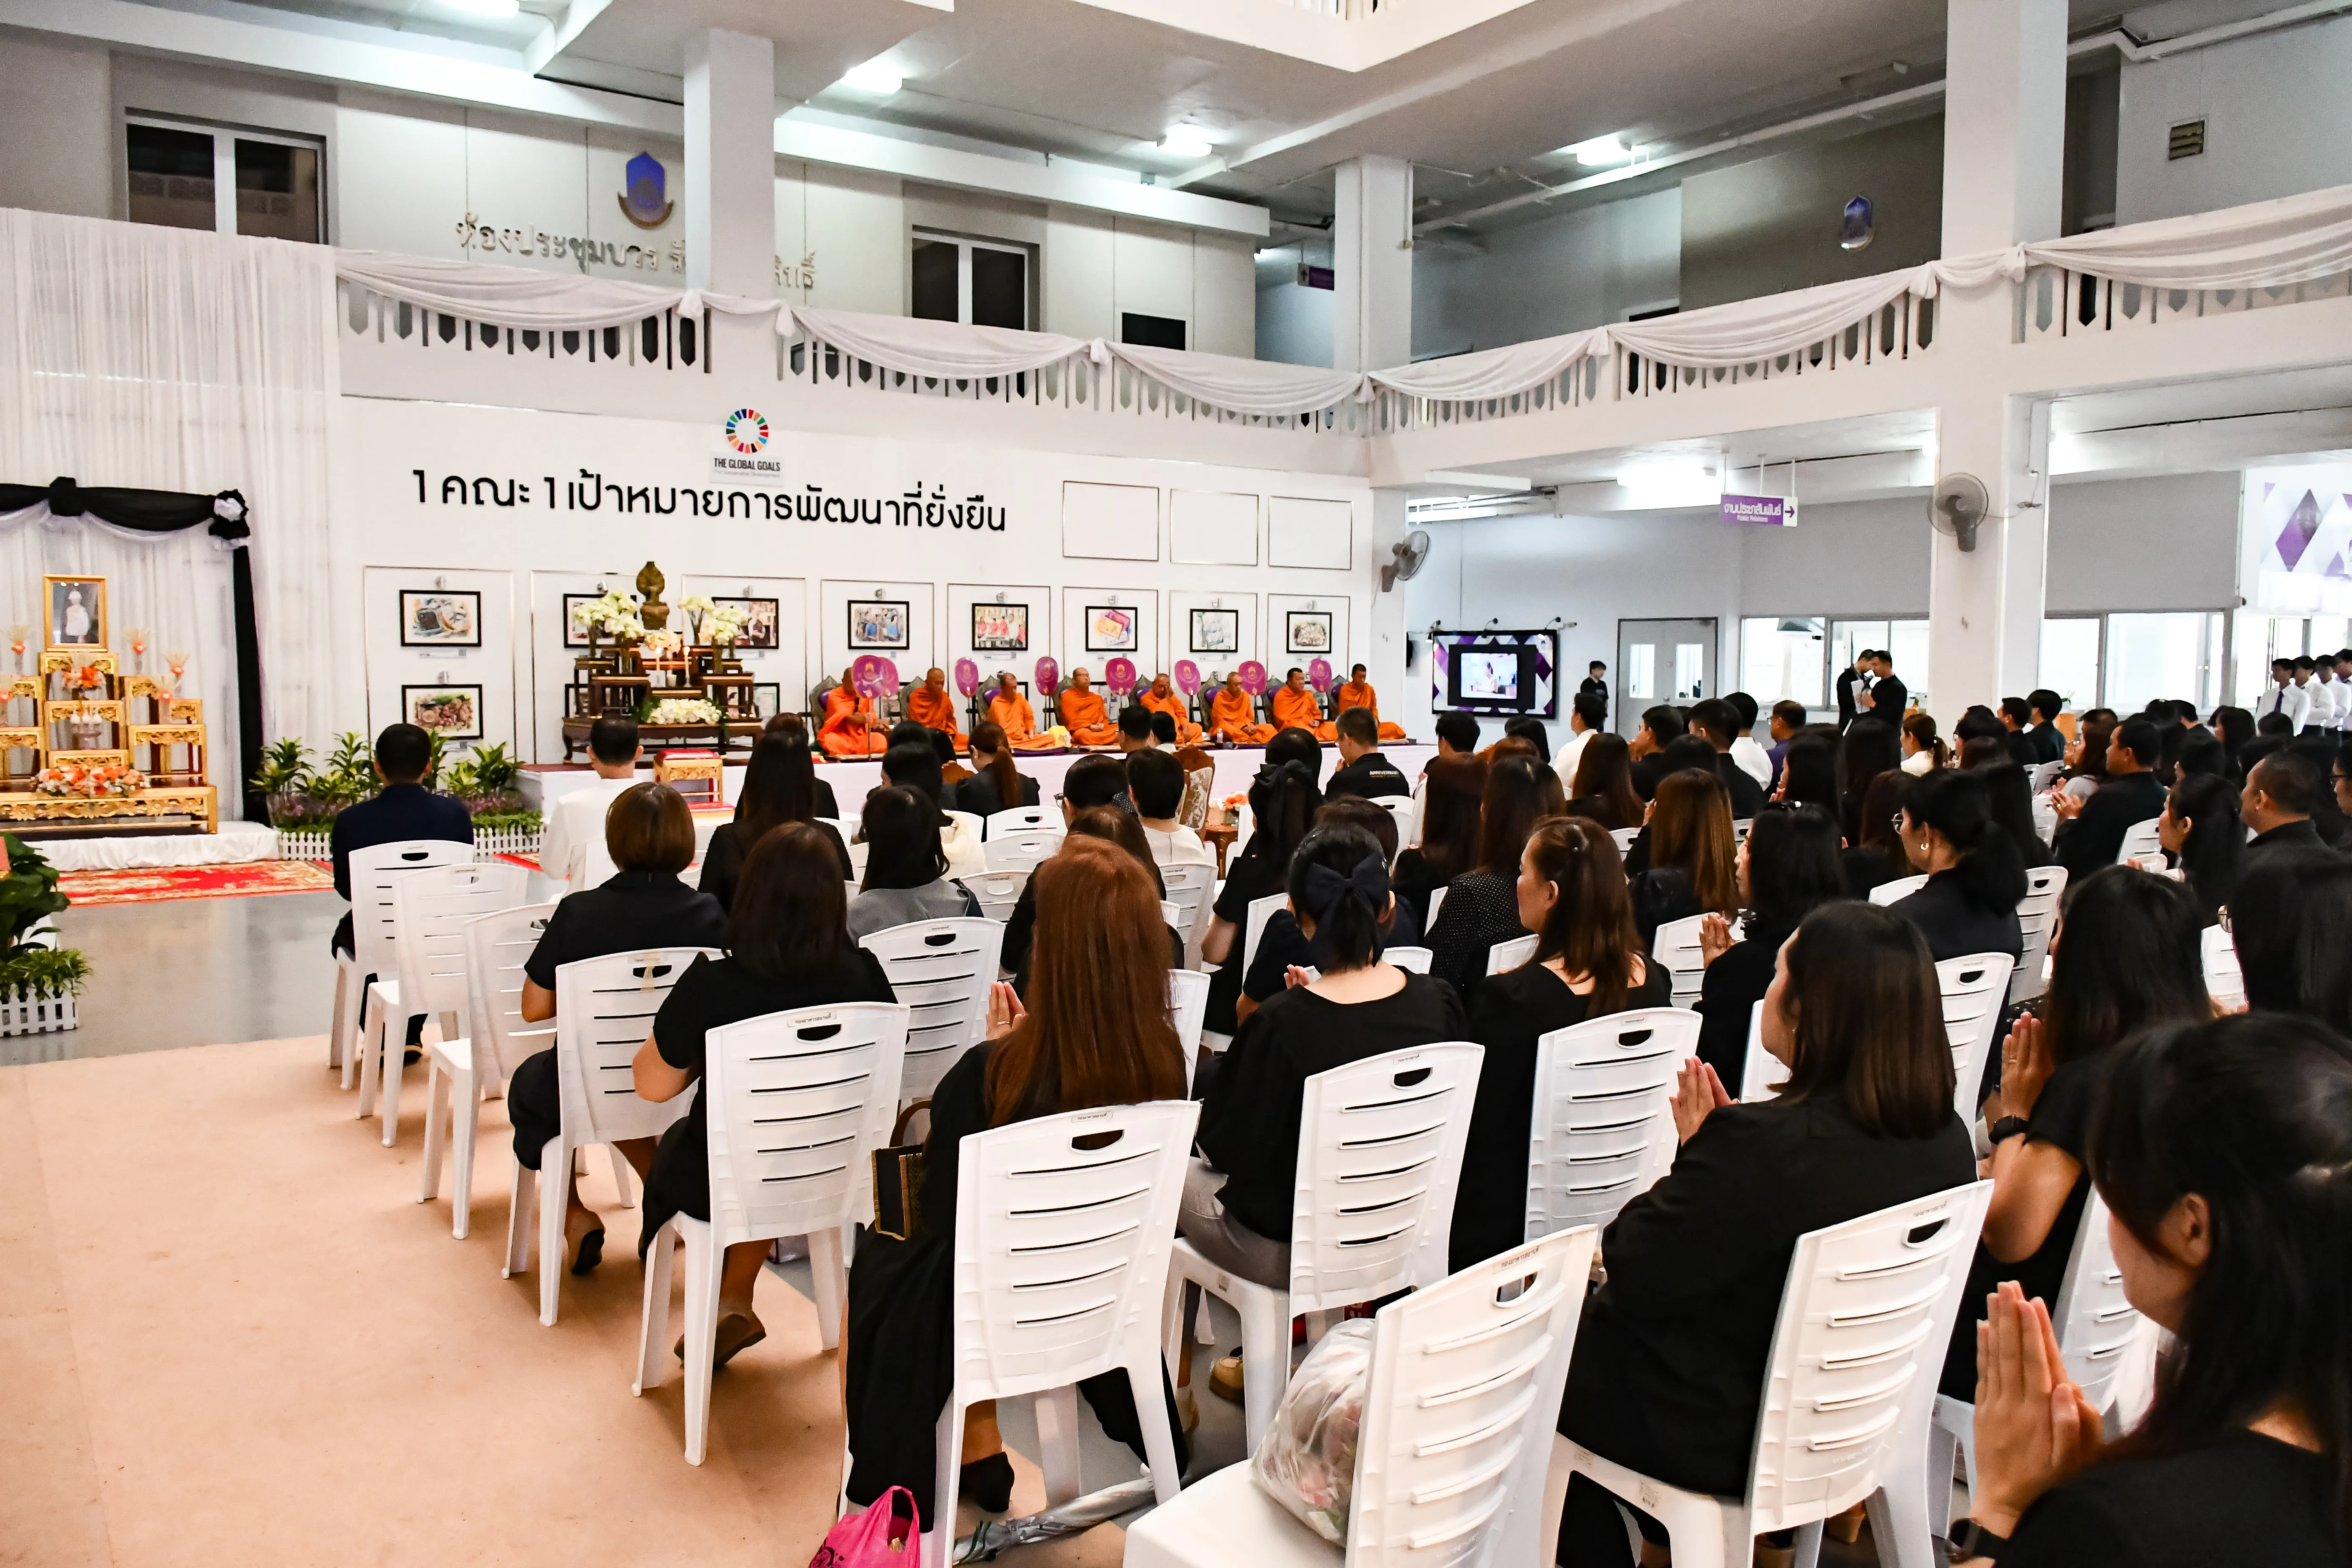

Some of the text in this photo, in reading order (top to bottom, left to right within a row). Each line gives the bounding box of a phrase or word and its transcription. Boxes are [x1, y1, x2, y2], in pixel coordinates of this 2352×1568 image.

[714, 457, 781, 471] THE GLOBAL GOALS
[413, 470, 425, 503] 1
[442, 476, 530, 507] คณะ
[544, 477, 555, 509] 1
